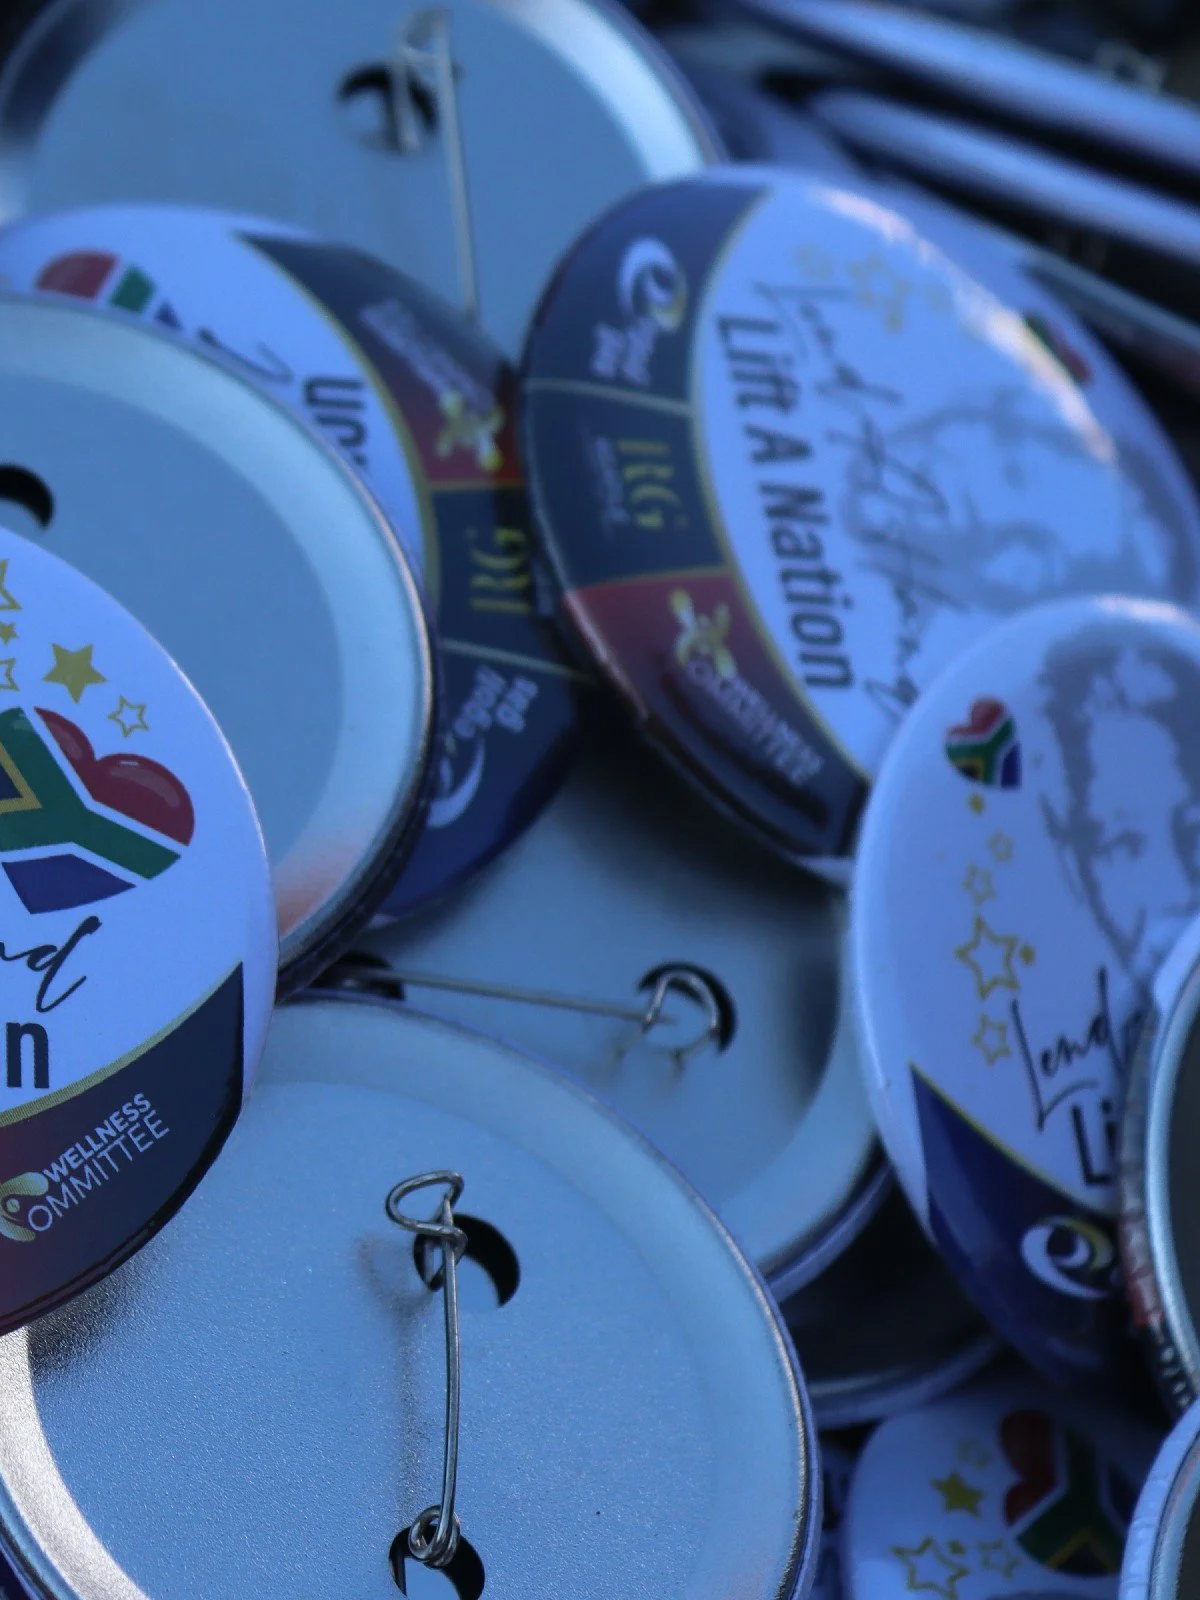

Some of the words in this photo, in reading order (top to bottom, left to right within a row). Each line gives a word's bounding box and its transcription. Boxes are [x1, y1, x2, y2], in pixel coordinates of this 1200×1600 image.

[718, 312, 802, 417] Lift
[744, 423, 814, 466] A
[759, 481, 856, 690] Nation
[43, 1092, 152, 1184] WELLNESS
